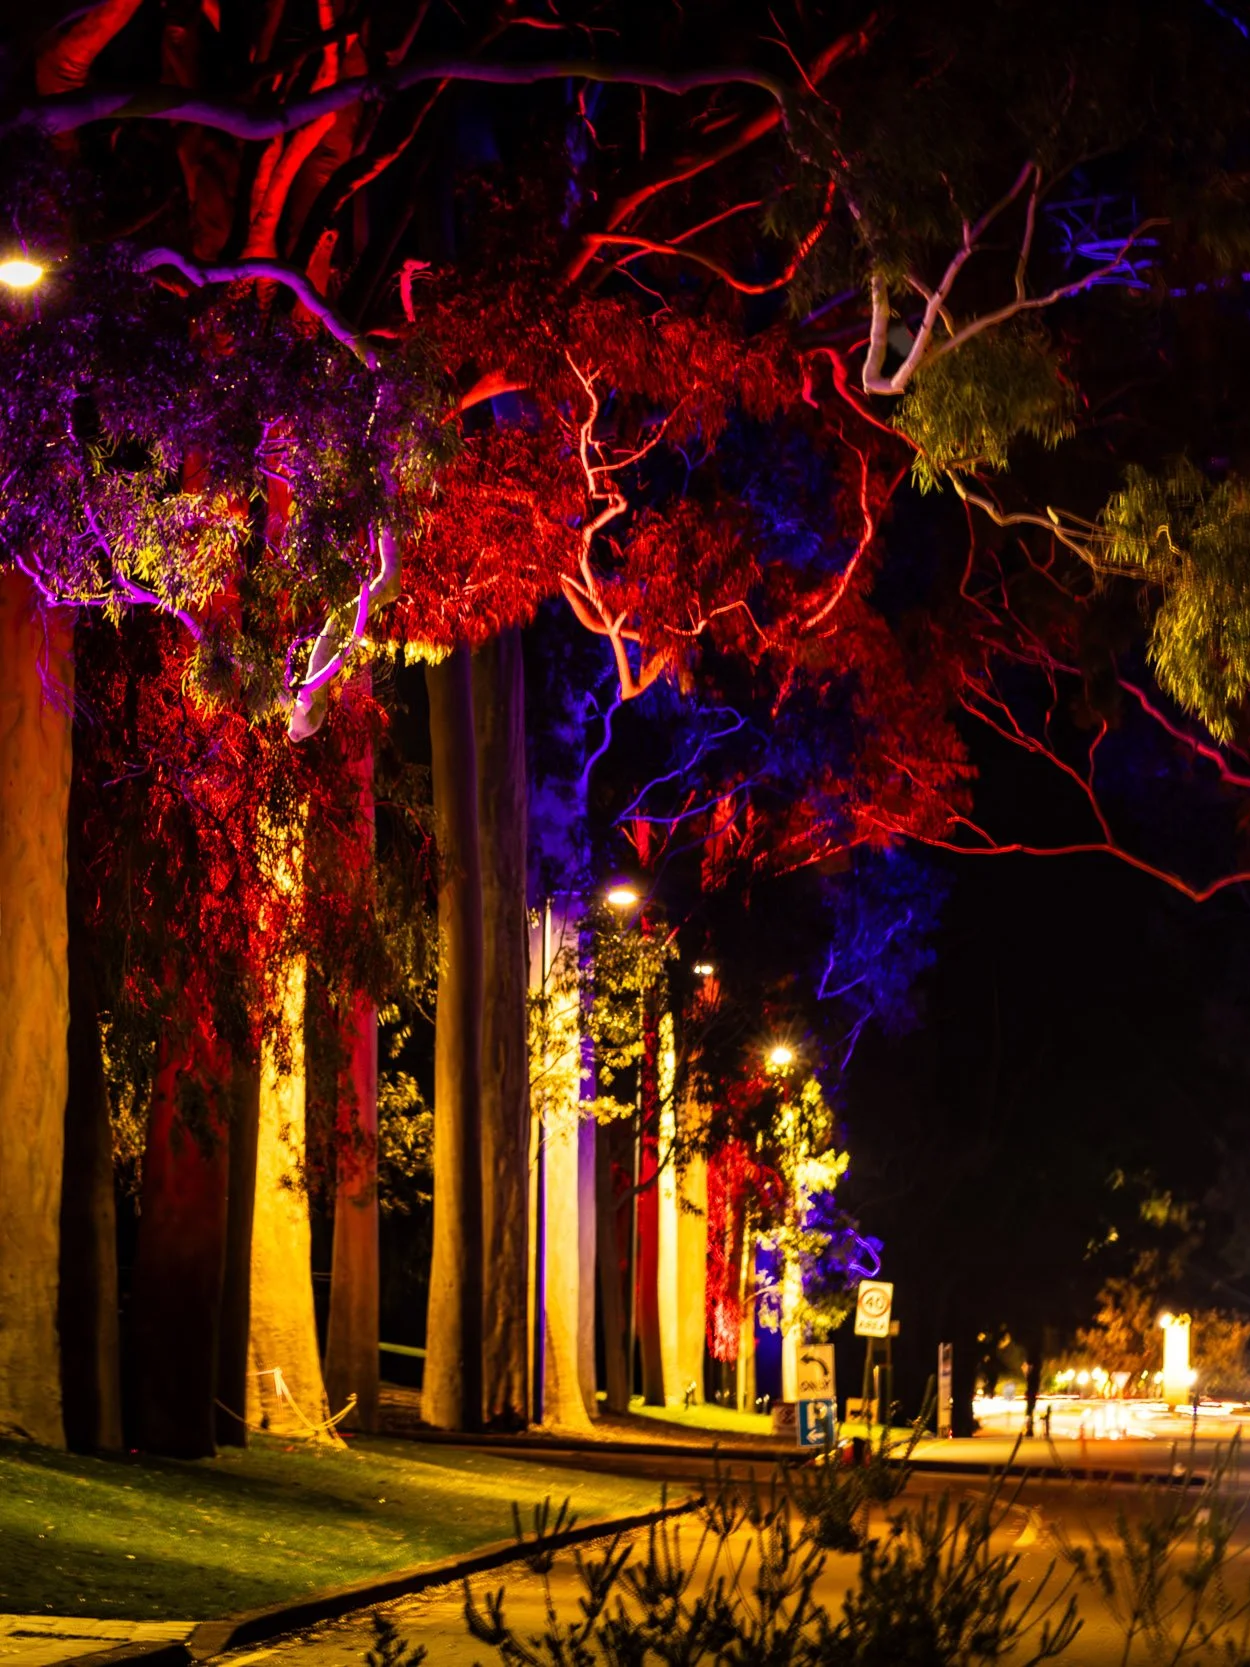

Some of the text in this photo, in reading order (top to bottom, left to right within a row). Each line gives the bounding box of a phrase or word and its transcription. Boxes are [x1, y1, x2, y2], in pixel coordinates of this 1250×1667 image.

[865, 1295, 885, 1310] 40
[859, 1320, 885, 1330] AREA
[800, 1379, 831, 1392] ONLY
[807, 1401, 828, 1430] P
